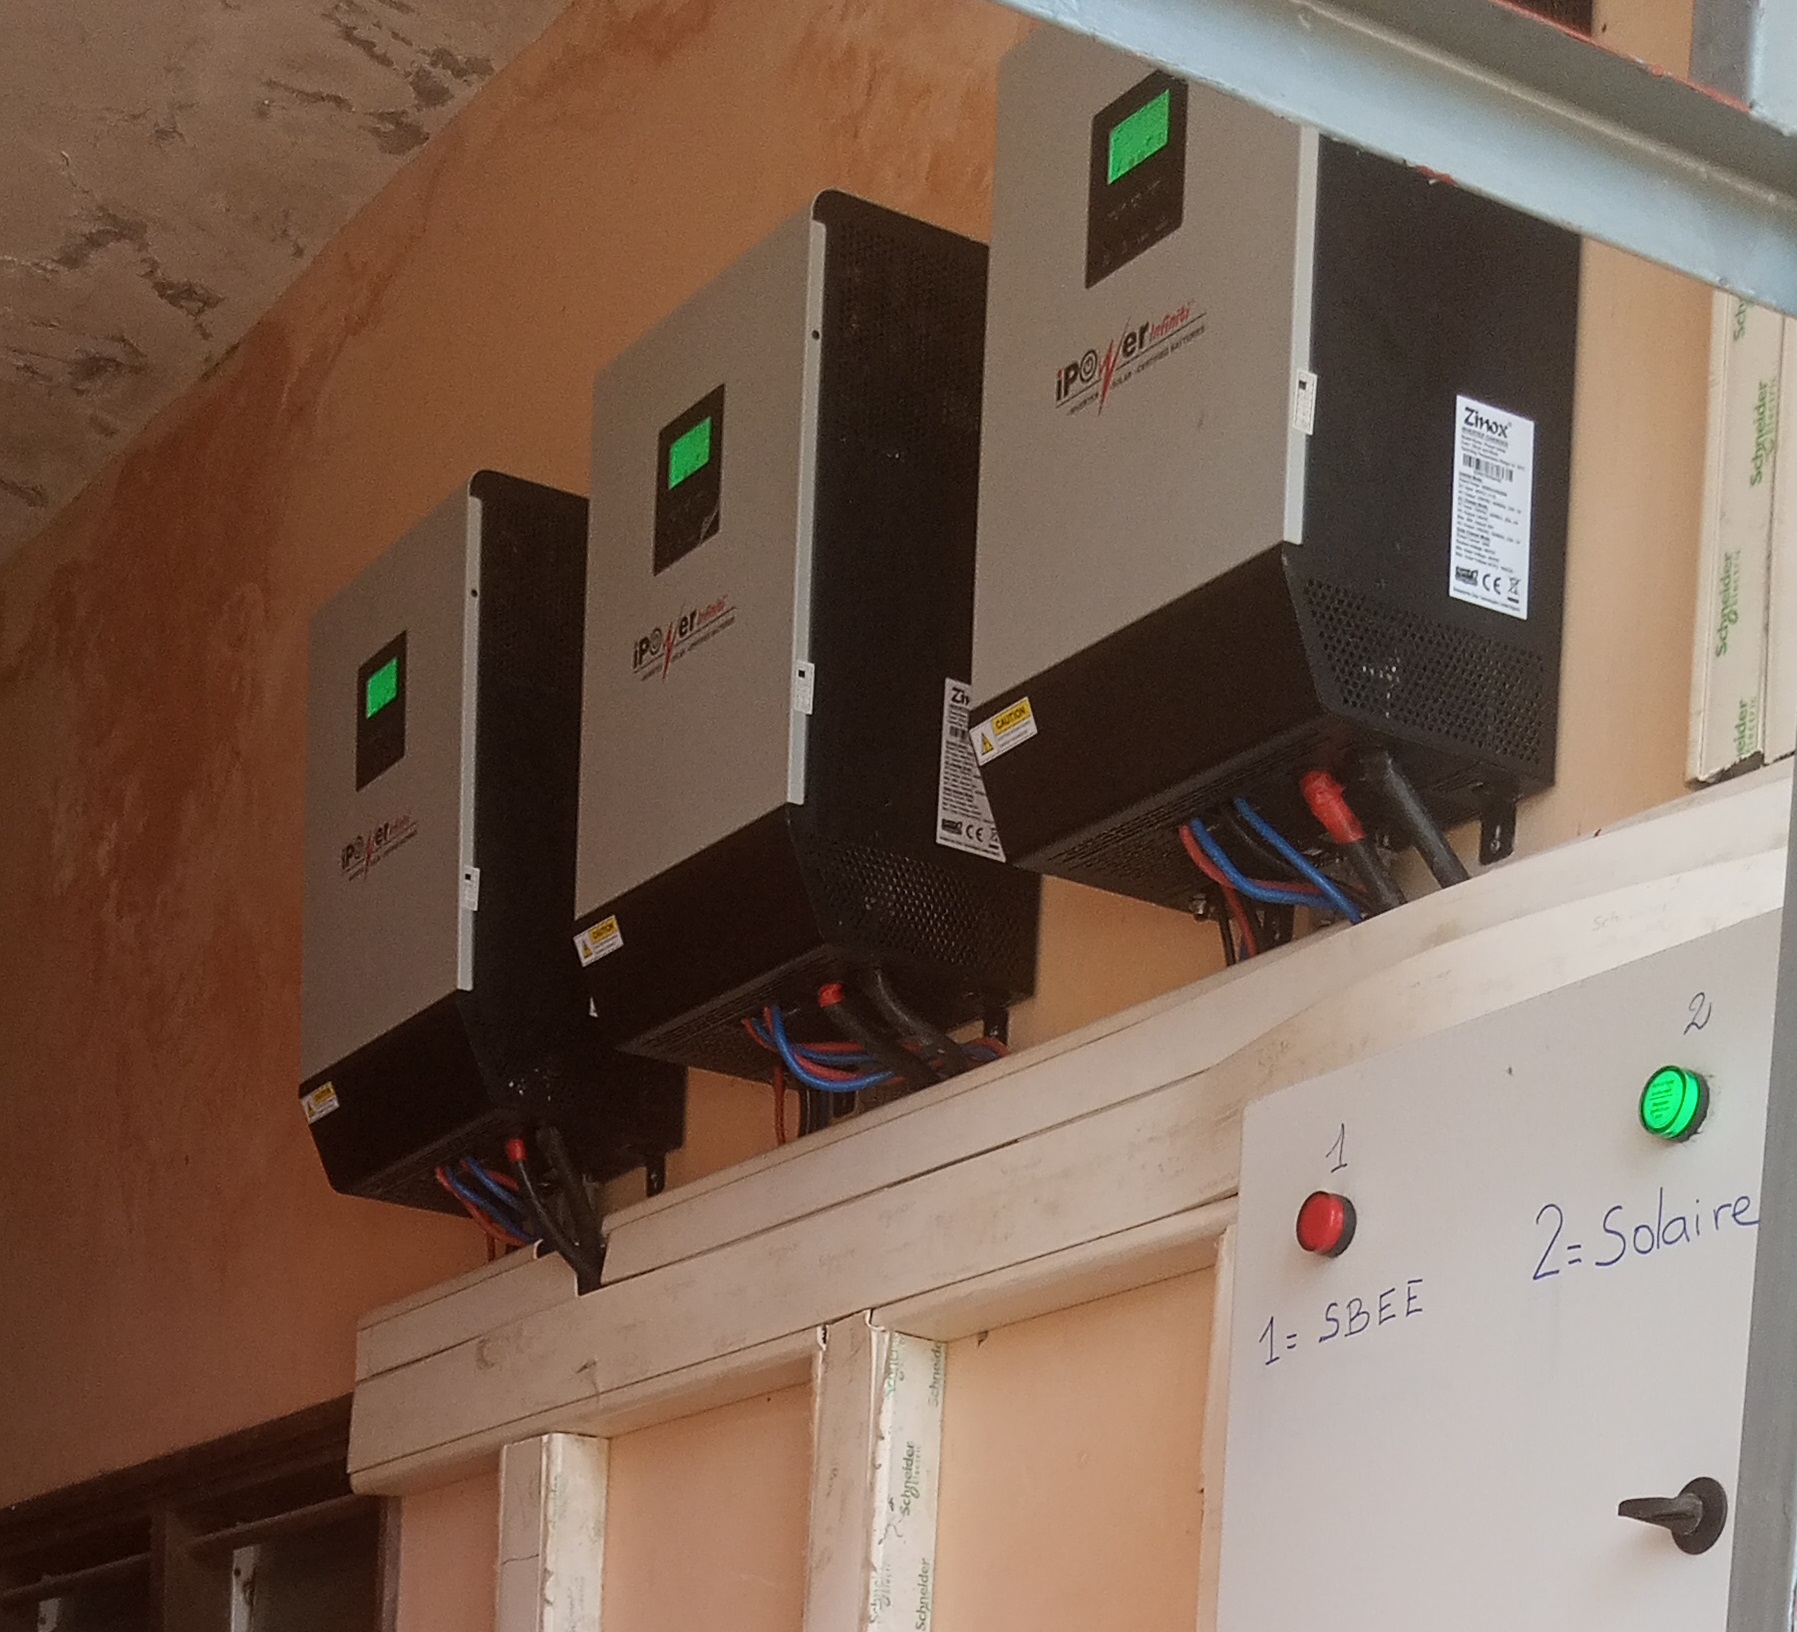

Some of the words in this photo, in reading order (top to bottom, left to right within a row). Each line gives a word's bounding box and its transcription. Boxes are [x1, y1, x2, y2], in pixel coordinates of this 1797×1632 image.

[1715, 552, 1732, 657] Schneider
[994, 704, 1026, 730] CAUTION
[1683, 992, 1712, 1034] 2
[1325, 1123, 1348, 1173] 1
[1318, 1278, 1424, 1343] SBEE
[900, 1440, 916, 1516] Schneider
[916, 1557, 931, 1632] Schneider
